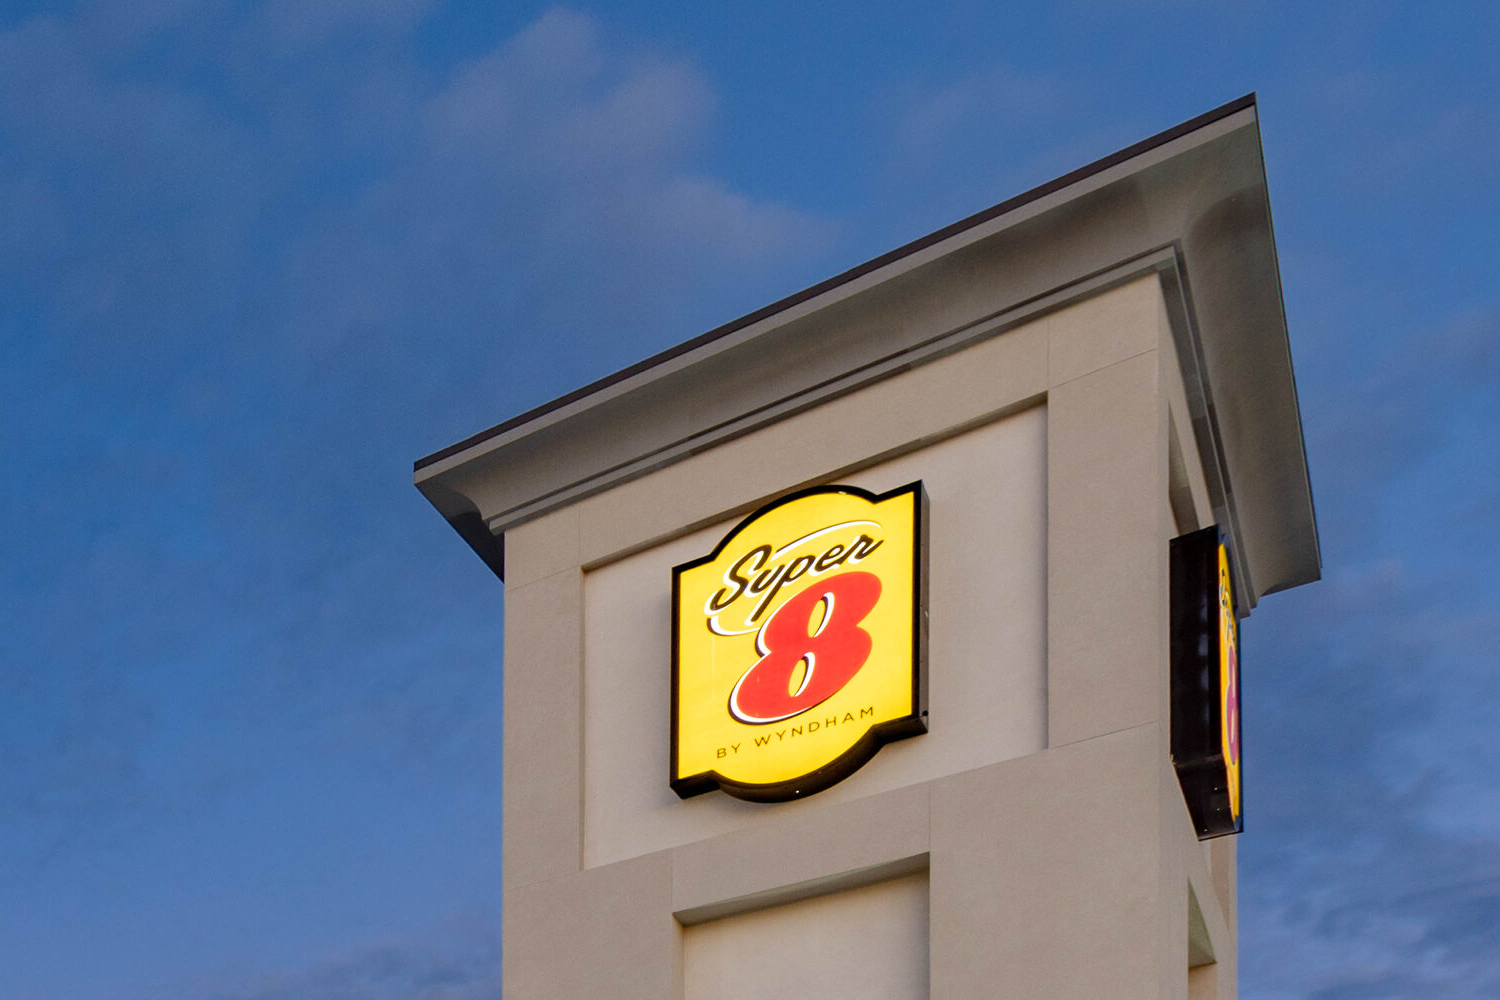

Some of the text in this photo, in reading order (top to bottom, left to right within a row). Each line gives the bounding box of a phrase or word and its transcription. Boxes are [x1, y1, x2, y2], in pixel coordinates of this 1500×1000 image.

[708, 533, 884, 622] Super
[728, 571, 882, 725] 8
[716, 706, 875, 760] BY WYNDHAM
